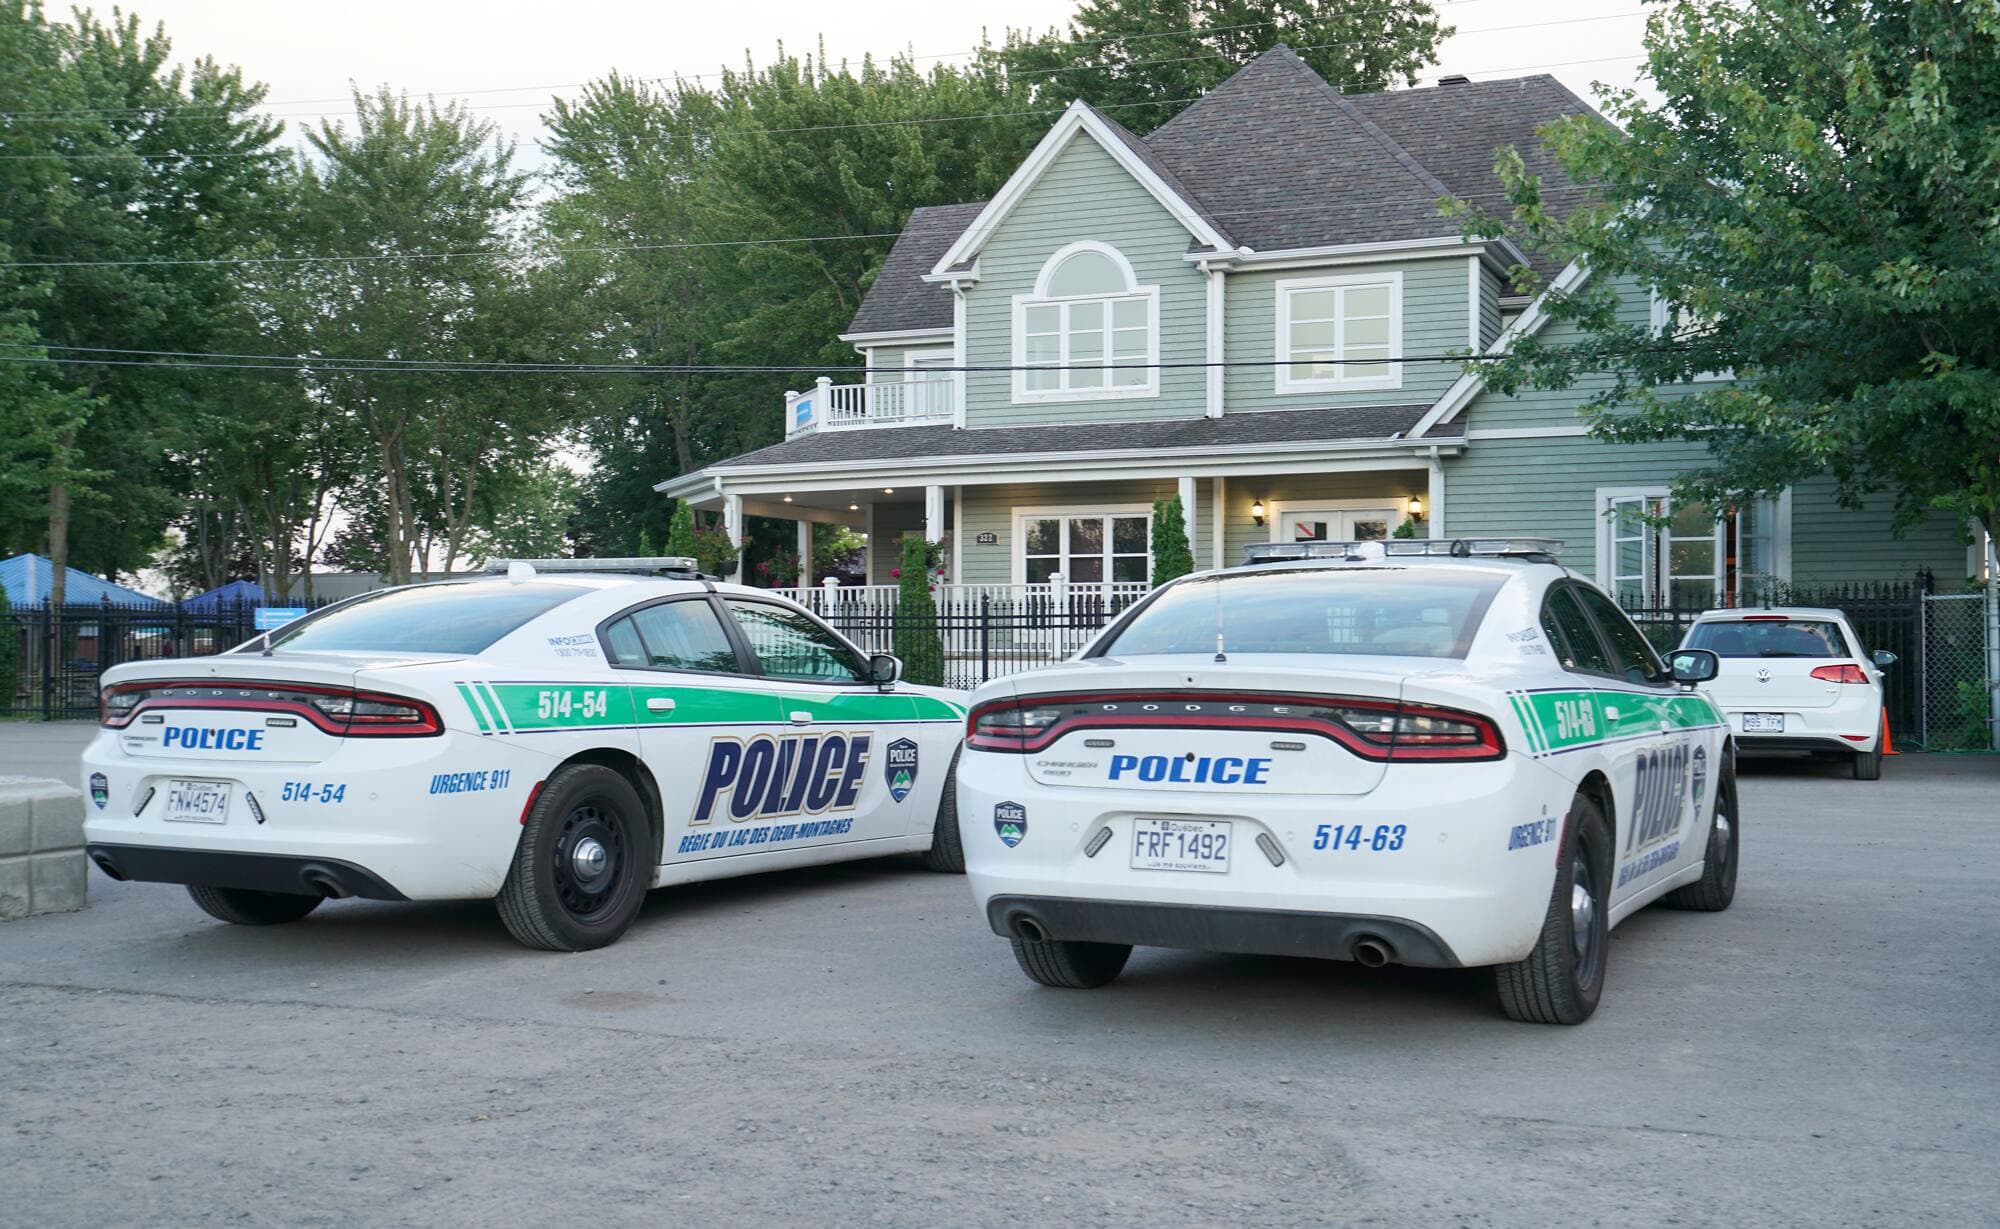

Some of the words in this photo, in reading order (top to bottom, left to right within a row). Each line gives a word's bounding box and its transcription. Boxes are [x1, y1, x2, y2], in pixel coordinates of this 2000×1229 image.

[538, 690, 607, 719] 514-54
[1103, 703, 1289, 714] DODGE
[163, 726, 265, 750] POLICE
[890, 749, 915, 762] POLICE
[430, 770, 488, 794] URGENCE
[490, 769, 510, 789] 911
[689, 731, 873, 826] POLICE
[1108, 755, 1273, 784] POLICE
[282, 782, 346, 803] 514-54
[678, 830, 711, 854] RÉGIE
[712, 832, 726, 849] DU
[728, 829, 749, 847] LAC
[750, 826, 770, 844] DES
[770, 818, 853, 842] DEUX-MONTAGNES
[1313, 824, 1407, 851] 514-63
